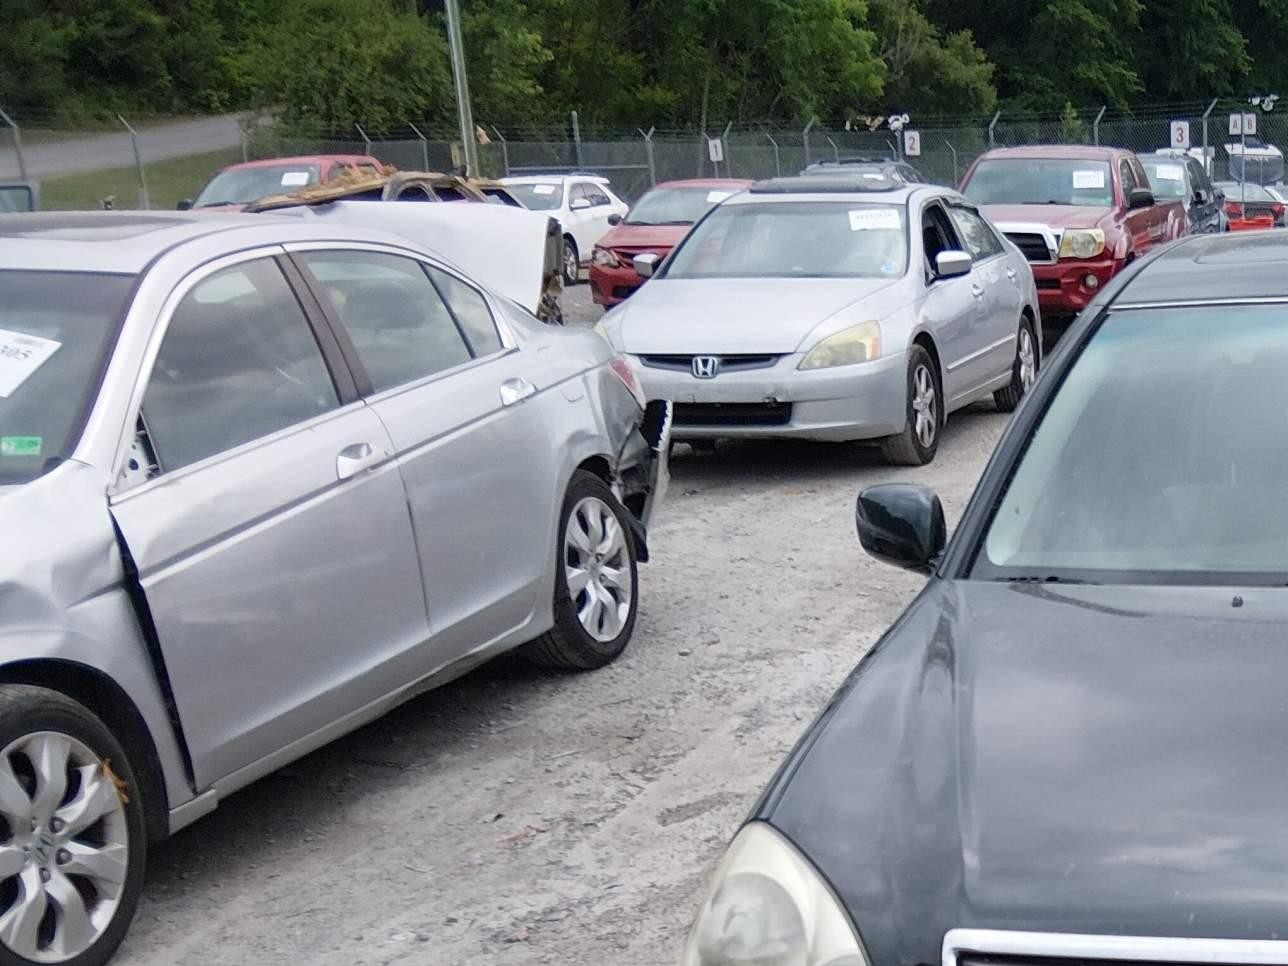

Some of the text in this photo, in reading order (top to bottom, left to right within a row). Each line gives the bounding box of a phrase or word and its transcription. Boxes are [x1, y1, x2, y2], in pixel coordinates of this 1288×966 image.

[1232, 120, 1238, 129] A
[1247, 120, 1253, 129] B
[1176, 127, 1184, 143] 3
[909, 136, 916, 151] 2
